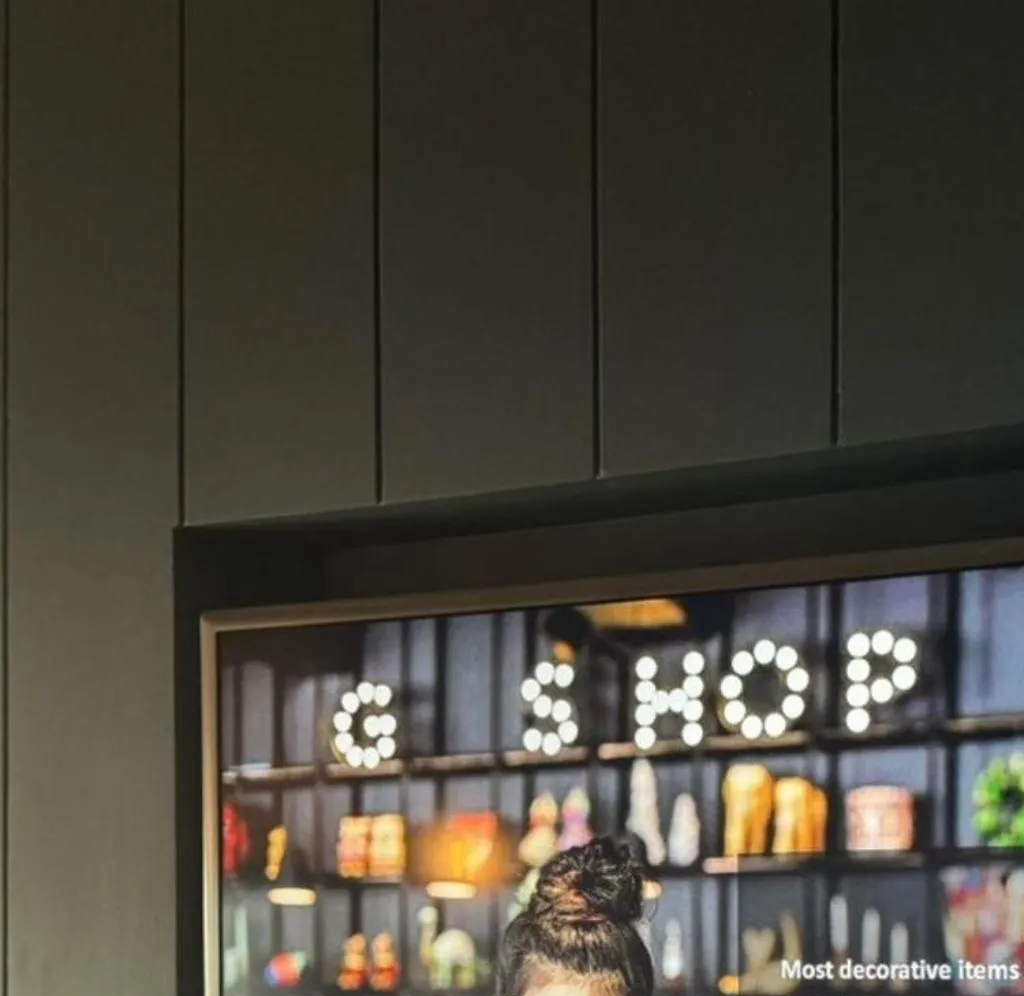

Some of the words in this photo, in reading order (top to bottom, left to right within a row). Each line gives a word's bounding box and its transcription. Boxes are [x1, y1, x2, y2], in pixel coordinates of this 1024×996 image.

[332, 680, 397, 769] G
[520, 629, 918, 757] SHOP
[780, 959, 834, 981] Most
[839, 957, 952, 981] decorative
[958, 959, 1020, 982] items
